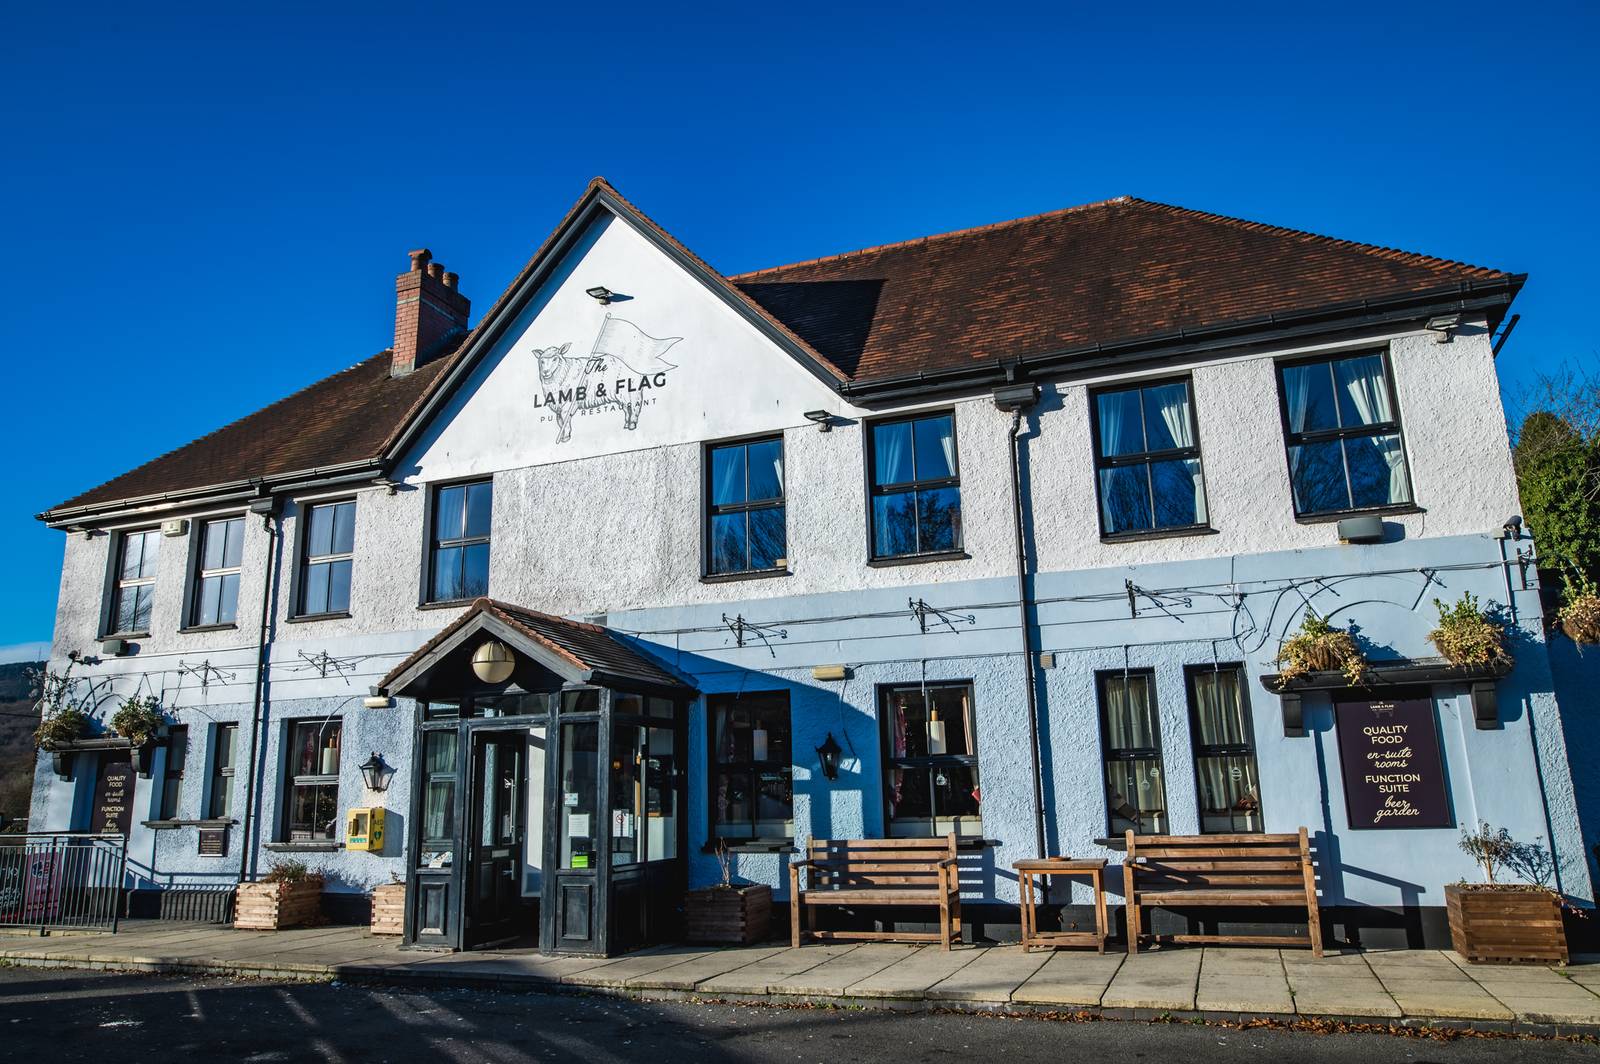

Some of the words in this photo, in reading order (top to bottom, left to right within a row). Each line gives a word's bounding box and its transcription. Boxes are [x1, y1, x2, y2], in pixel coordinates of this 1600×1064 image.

[585, 357, 608, 374] The
[533, 386, 587, 409] LAMB
[595, 383, 607, 398] &
[615, 372, 667, 395] FLAG
[1363, 725, 1408, 736] QUALITY
[1371, 735, 1403, 745] FOOD
[1367, 746, 1413, 759] en-suite
[1375, 760, 1408, 768] rooms
[1365, 774, 1420, 783] FUNCTION
[1379, 784, 1410, 793] SUITE
[1384, 795, 1408, 808] beer
[1374, 802, 1420, 823] garden
